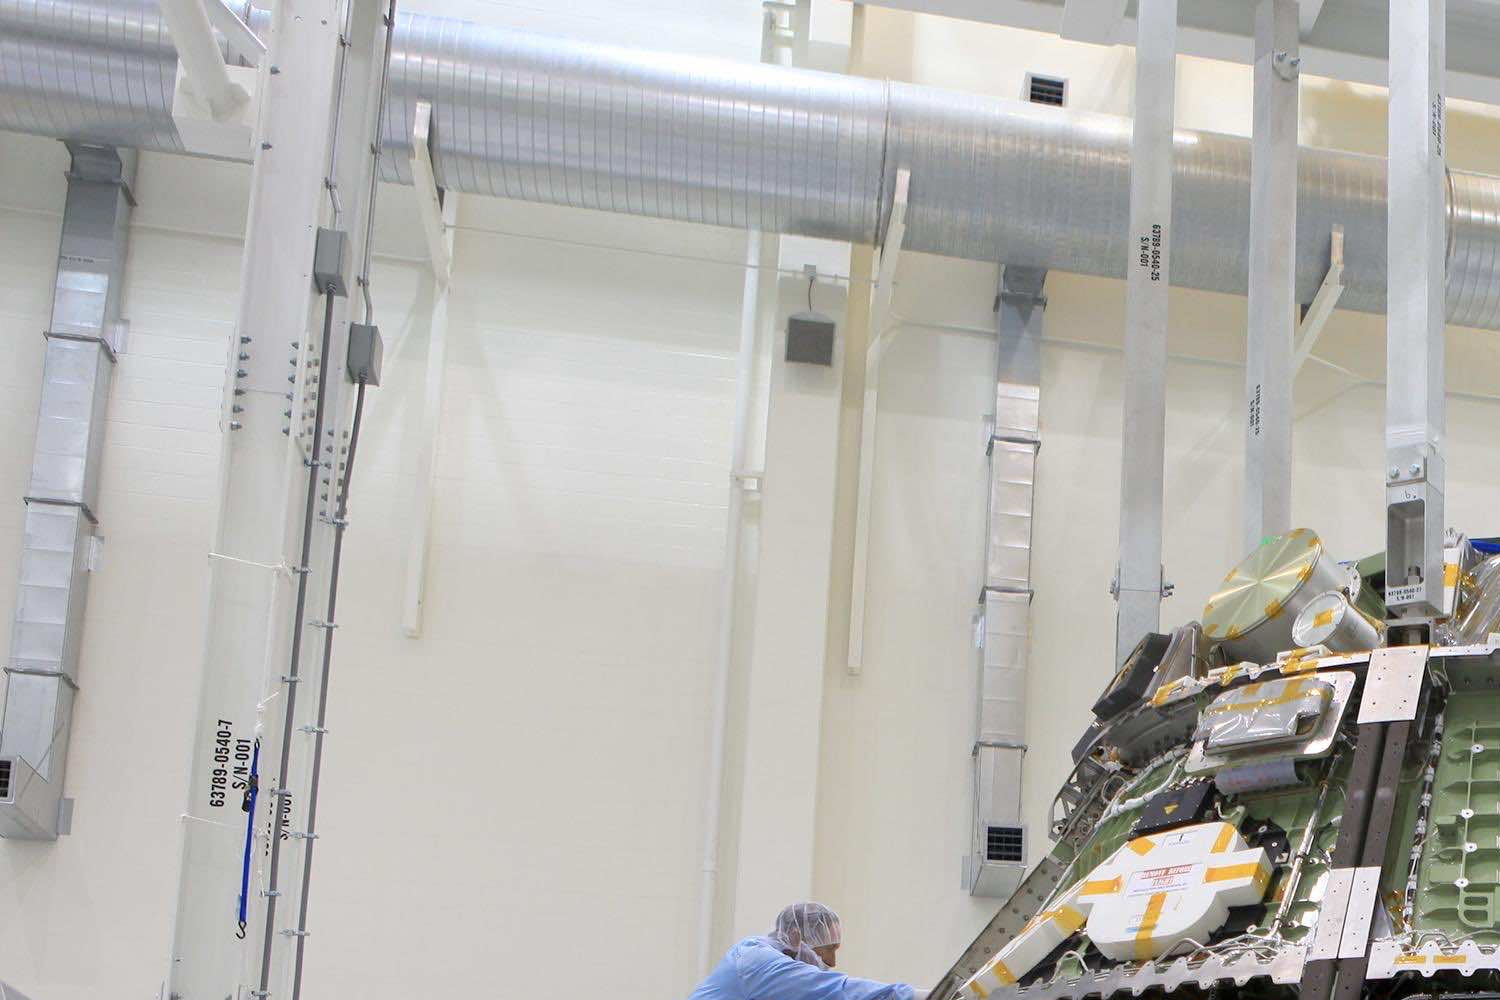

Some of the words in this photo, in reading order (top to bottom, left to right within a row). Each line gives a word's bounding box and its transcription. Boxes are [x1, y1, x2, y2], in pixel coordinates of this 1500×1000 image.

[1140, 237, 1150, 267] S/N-001
[1151, 224, 1161, 281] 63789-0540-25
[210, 719, 232, 808] 63789-0540-7
[232, 738, 251, 790] S/N-001
